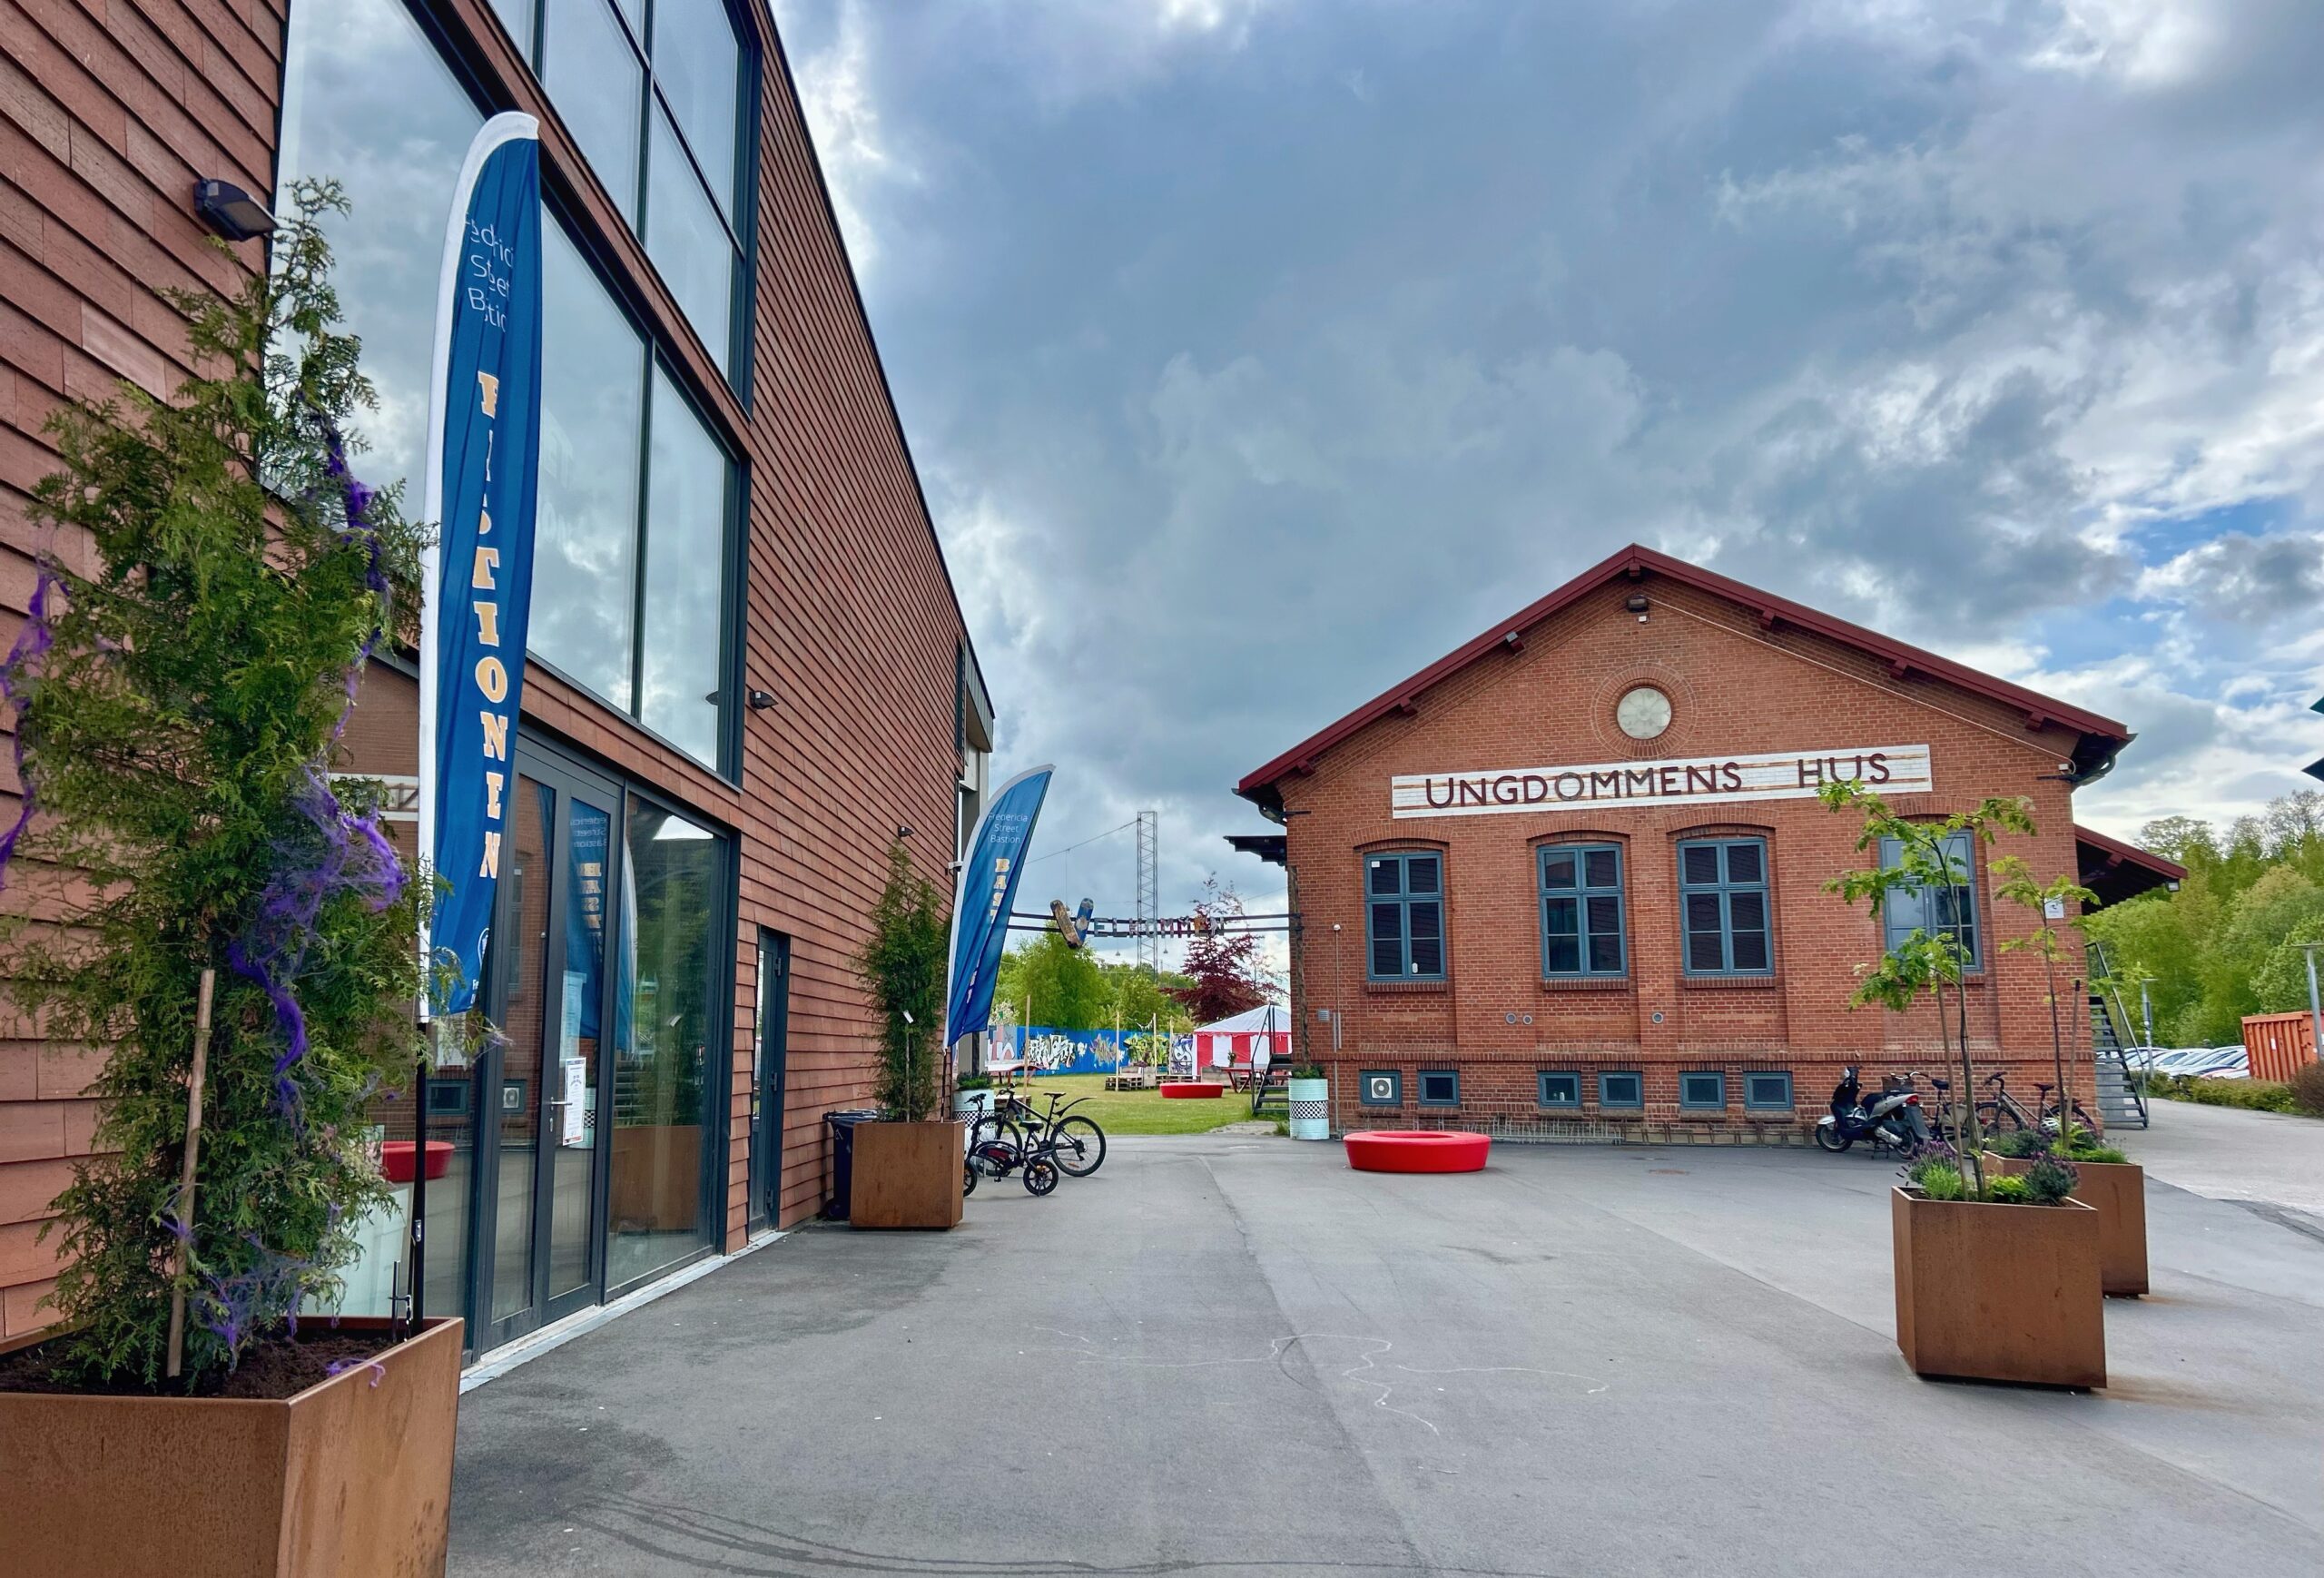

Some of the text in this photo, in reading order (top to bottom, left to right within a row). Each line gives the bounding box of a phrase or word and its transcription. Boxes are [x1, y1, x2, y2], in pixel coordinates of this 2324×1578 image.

[1425, 753, 1890, 809] UNGDOMMENS HUS
[989, 813, 1028, 823] Fredericia
[994, 824, 1019, 833] Street
[990, 834, 1021, 844] Bastion
